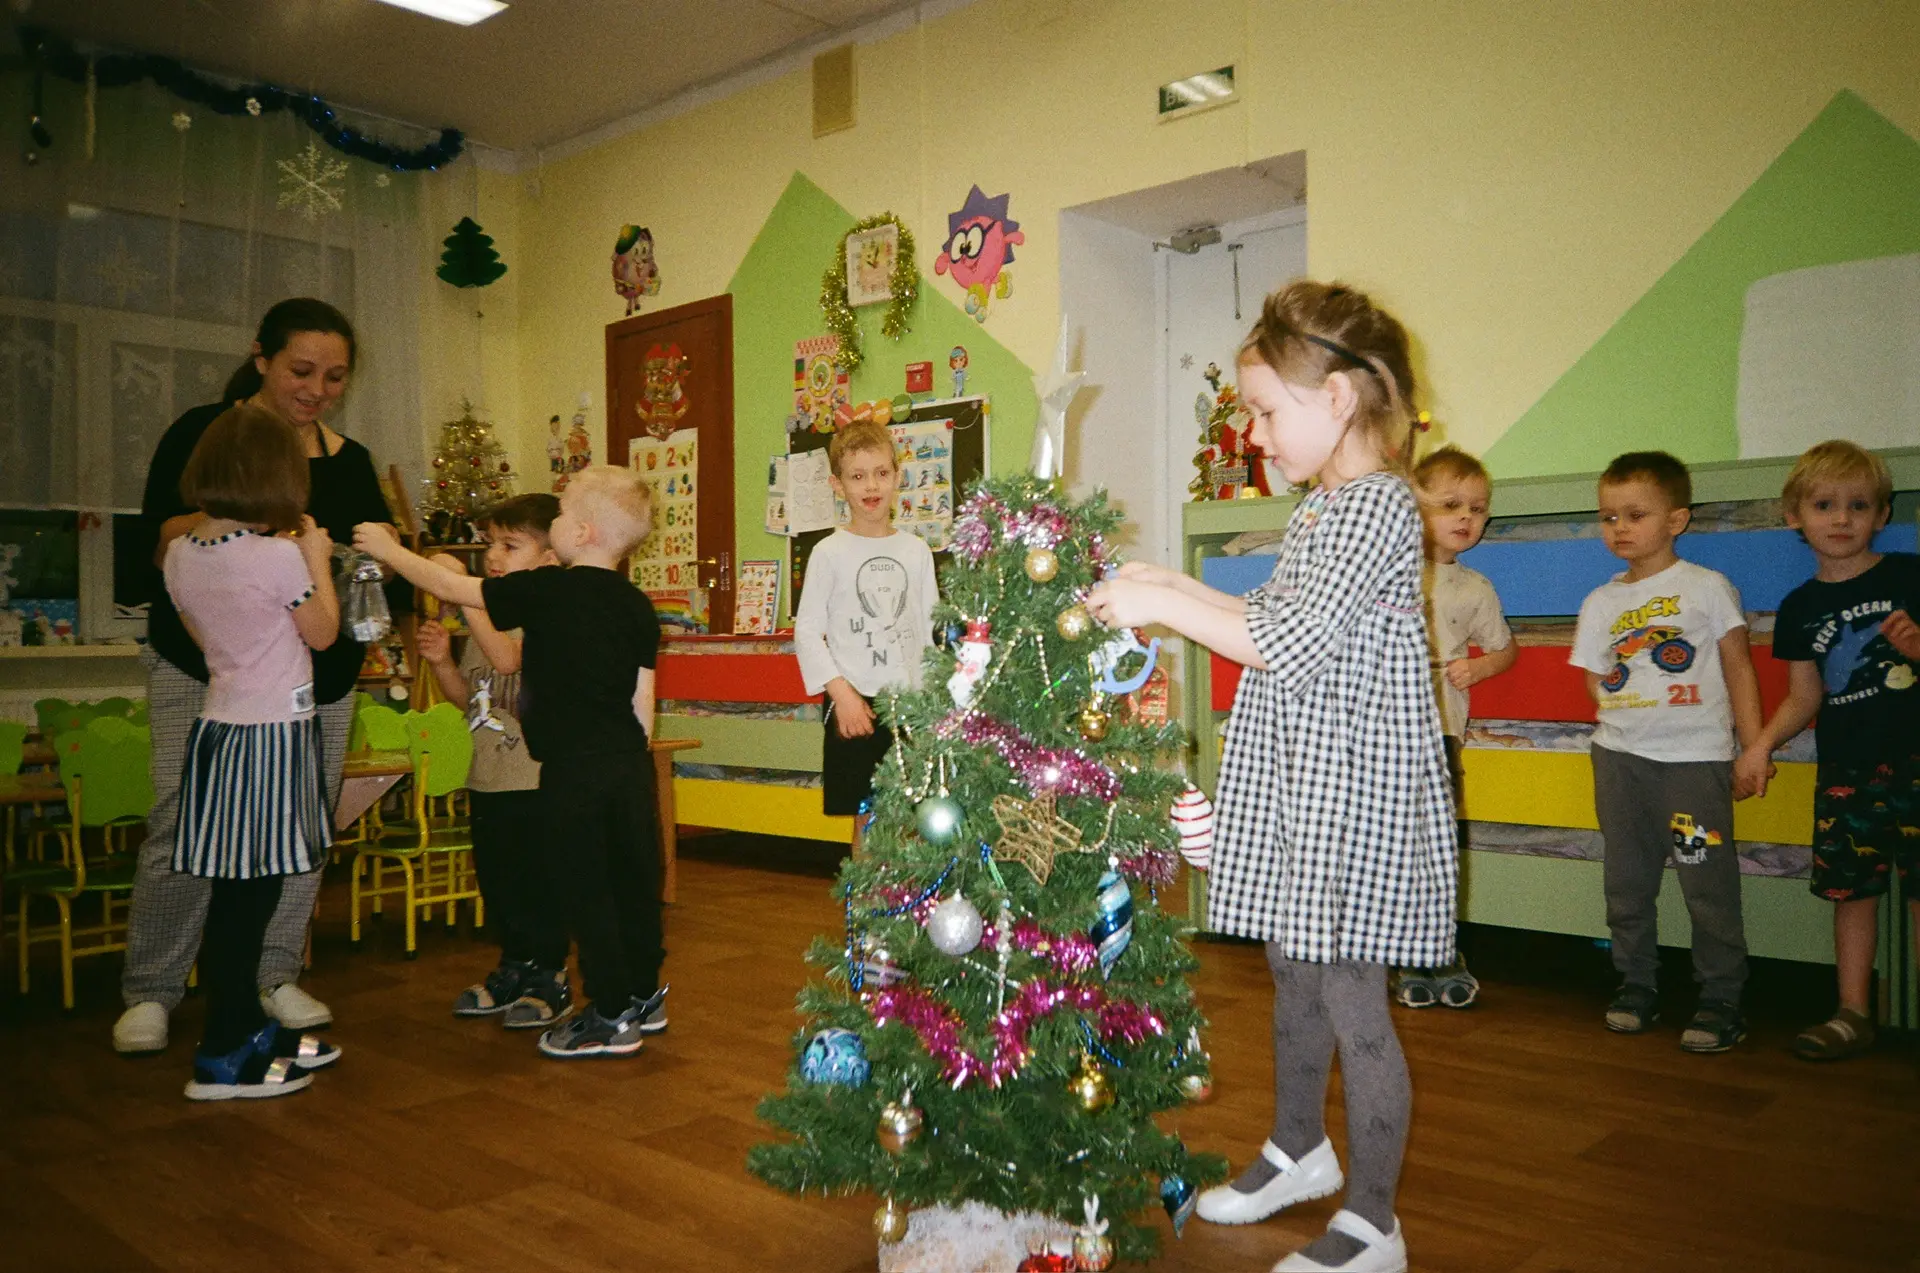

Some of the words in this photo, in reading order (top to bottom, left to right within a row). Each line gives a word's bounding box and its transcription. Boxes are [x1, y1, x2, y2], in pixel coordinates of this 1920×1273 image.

[634, 452, 640, 473] 1
[666, 447, 676, 468] 2
[666, 477, 676, 497] 4
[666, 506, 676, 527] 6
[664, 535, 673, 556] 8
[633, 566, 641, 586] 9
[665, 564, 680, 585] 10
[870, 563, 896, 571] DUDE
[1812, 619, 1839, 653] DEEP
[1840, 600, 1893, 622] OCEAN
[1666, 683, 1703, 706] 21
